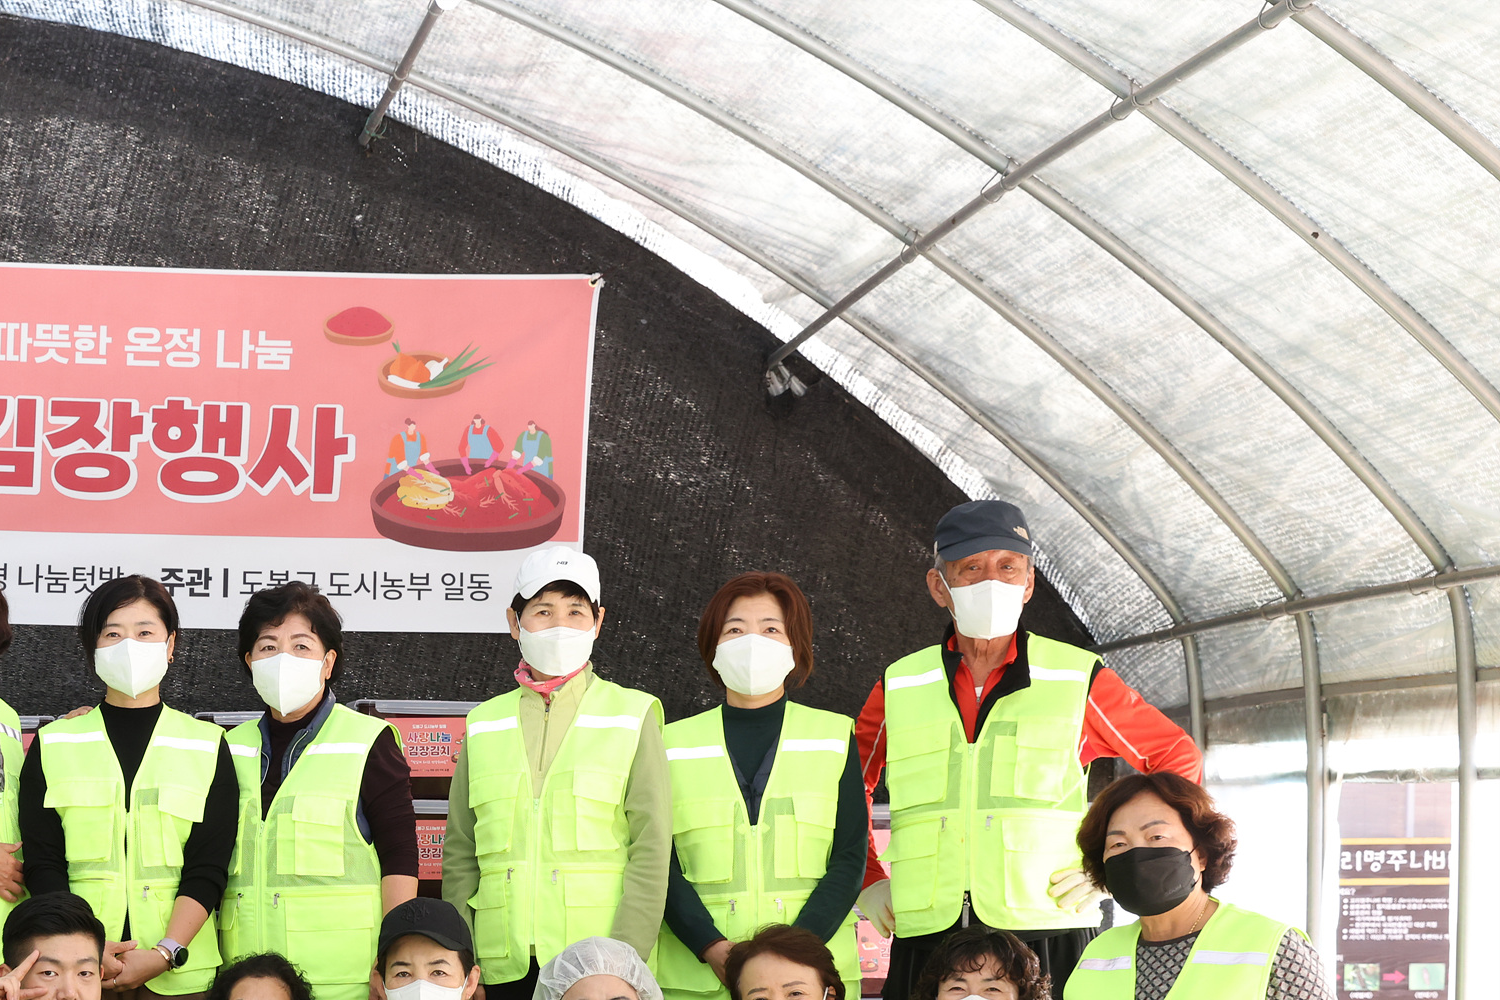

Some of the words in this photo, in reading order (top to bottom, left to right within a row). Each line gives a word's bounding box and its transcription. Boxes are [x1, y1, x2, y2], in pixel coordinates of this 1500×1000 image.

[124, 325, 202, 369] 온정
[215, 329, 293, 371] 나눔
[160, 567, 212, 597] 주관
[326, 571, 432, 601] 도시농부
[441, 572, 493, 601] 일동
[407, 732, 452, 743] 사랑나눔
[408, 745, 450, 757] 김장김치
[419, 848, 442, 859] 장김
